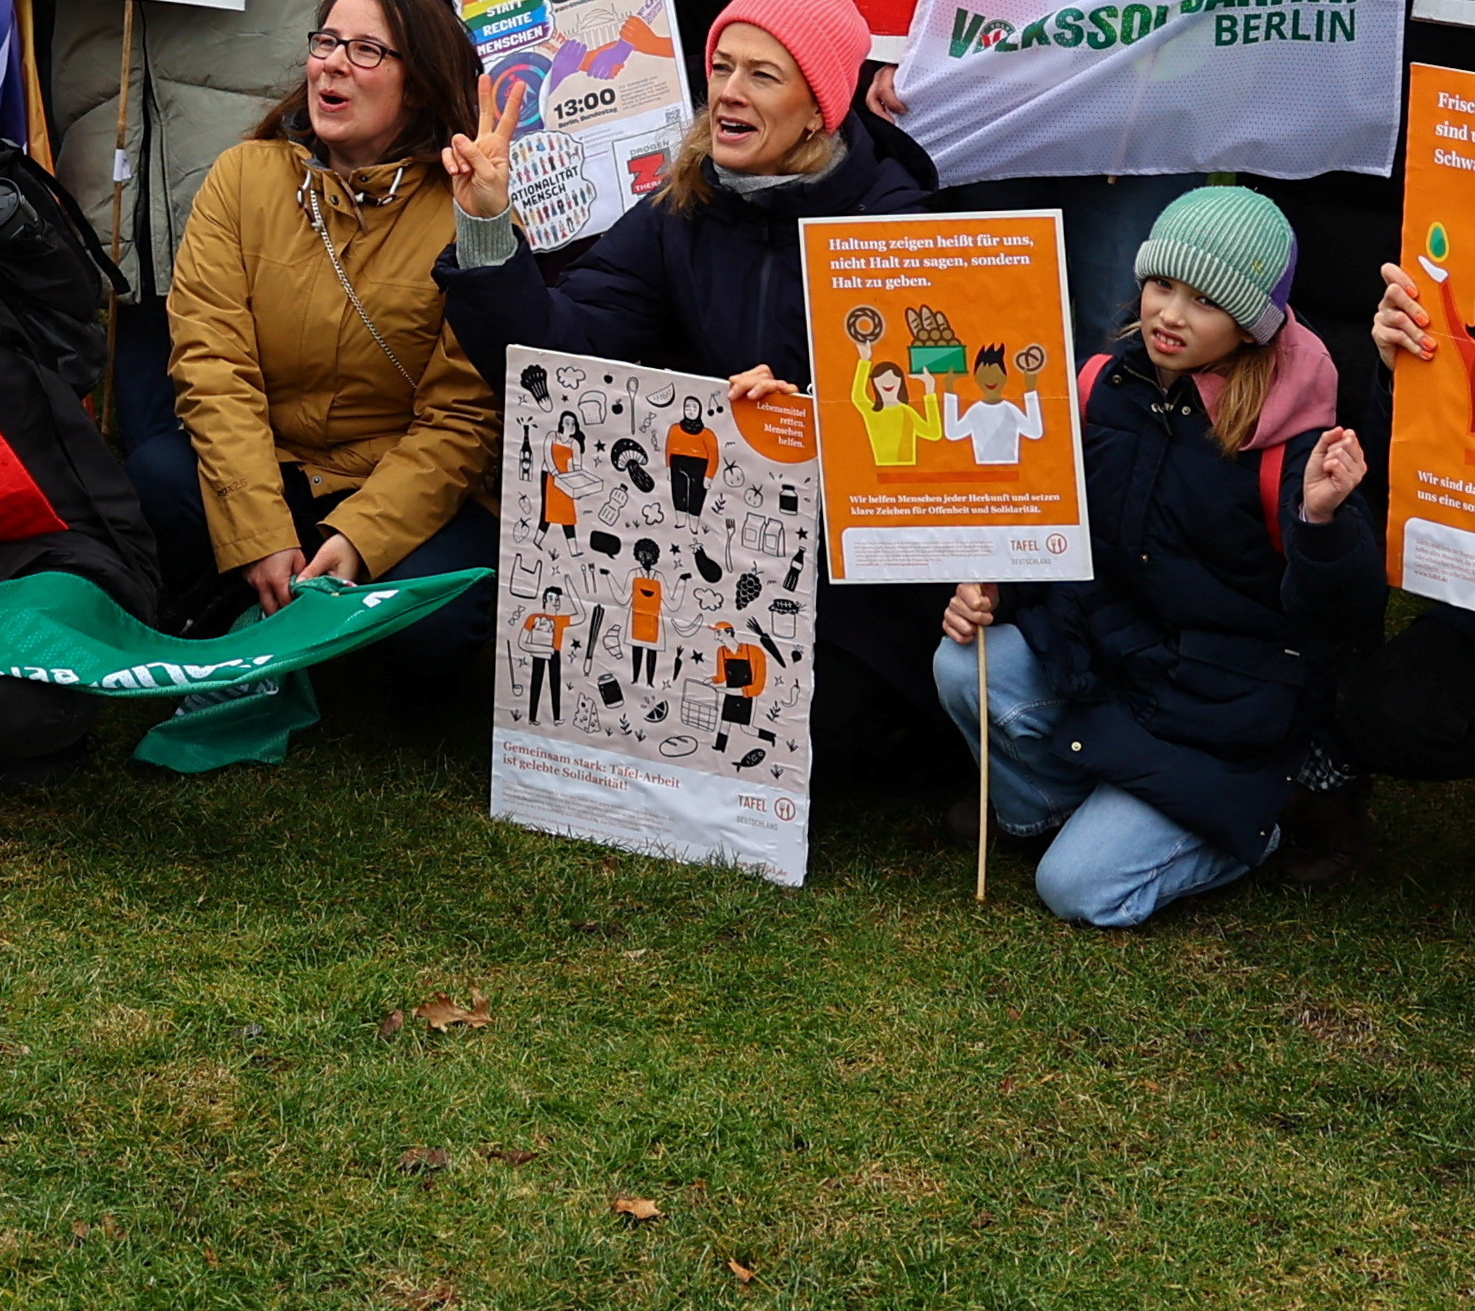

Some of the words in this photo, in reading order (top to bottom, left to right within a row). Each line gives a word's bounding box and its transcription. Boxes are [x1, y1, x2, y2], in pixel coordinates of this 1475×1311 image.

[483, 12, 533, 37] RECHTE
[1215, 4, 1356, 47] BERLIN
[477, 25, 544, 57] MENSCHEN
[553, 88, 616, 120] 13:00
[580, 107, 618, 123] Bundestag
[1435, 121, 1468, 141] sind
[629, 139, 670, 157] DROGEN
[510, 165, 580, 204] ATIONALITÄT
[522, 183, 567, 209] MENSCH
[829, 236, 887, 252] Haltung
[889, 236, 934, 251] zeigen
[937, 234, 974, 248] heißt
[977, 233, 999, 247] für
[1003, 234, 1035, 249] uns,
[830, 256, 866, 270] nicht
[869, 255, 900, 269] Halt
[902, 257, 921, 270] zu
[923, 255, 969, 270] sagen,
[971, 253, 1030, 267] sondern
[831, 275, 863, 289] Halt
[865, 277, 883, 289] zu
[885, 274, 932, 290] geben.
[757, 402, 807, 419] Lebensmittel
[764, 423, 804, 438] Menschen
[780, 417, 806, 429] retten.
[778, 435, 805, 449] helfen.
[1417, 470, 1438, 486] Wir
[1439, 474, 1462, 491] sind
[850, 495, 867, 503] Wir
[868, 494, 896, 504] helfen
[897, 493, 942, 504] Menschen
[943, 493, 967, 504] jeder
[968, 493, 1010, 503] Herkunft
[1012, 493, 1029, 502] und
[1031, 492, 1060, 502] setzen
[1417, 491, 1437, 506] uns
[1438, 493, 1461, 510] eine
[850, 506, 874, 516] klare
[876, 505, 910, 516] Zeichen
[912, 505, 927, 515] für
[928, 505, 969, 515] Offenheit
[971, 505, 988, 515] und
[990, 505, 1042, 515] Solidarität.
[1010, 539, 1039, 552] TAFEL
[503, 740, 571, 766] Gemeinsam
[573, 757, 606, 774] stark:
[609, 765, 681, 790] Tafel-Arbeit
[503, 754, 518, 765] ist
[519, 758, 561, 776] gelebte
[562, 767, 628, 791] Solidarität!
[737, 793, 768, 813] TAFEL
